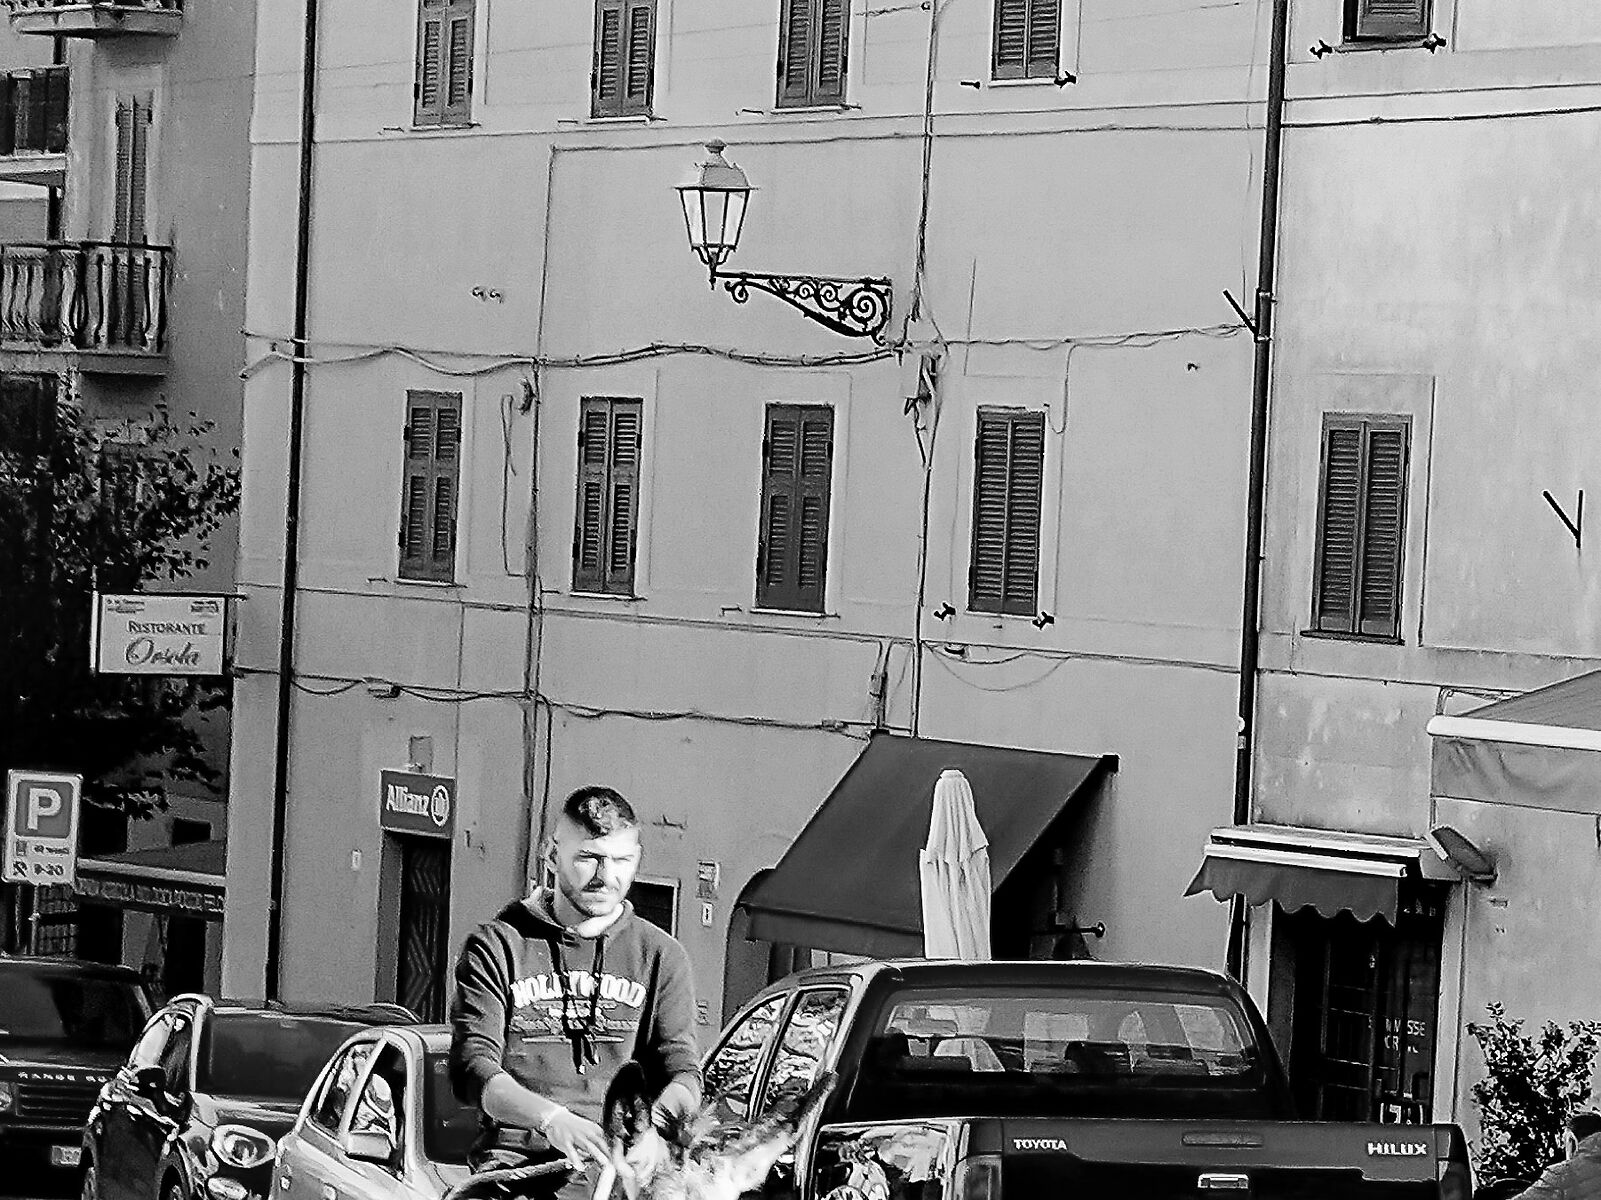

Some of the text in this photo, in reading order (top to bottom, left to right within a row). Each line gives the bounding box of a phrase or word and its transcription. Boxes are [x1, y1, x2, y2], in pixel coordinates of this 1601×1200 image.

[128, 620, 206, 635] RISTORANTE
[386, 784, 430, 816] Allianz
[27, 787, 62, 830] P
[1014, 1138, 1068, 1150] TOYOTA
[1367, 1142, 1427, 1155] HILUX
